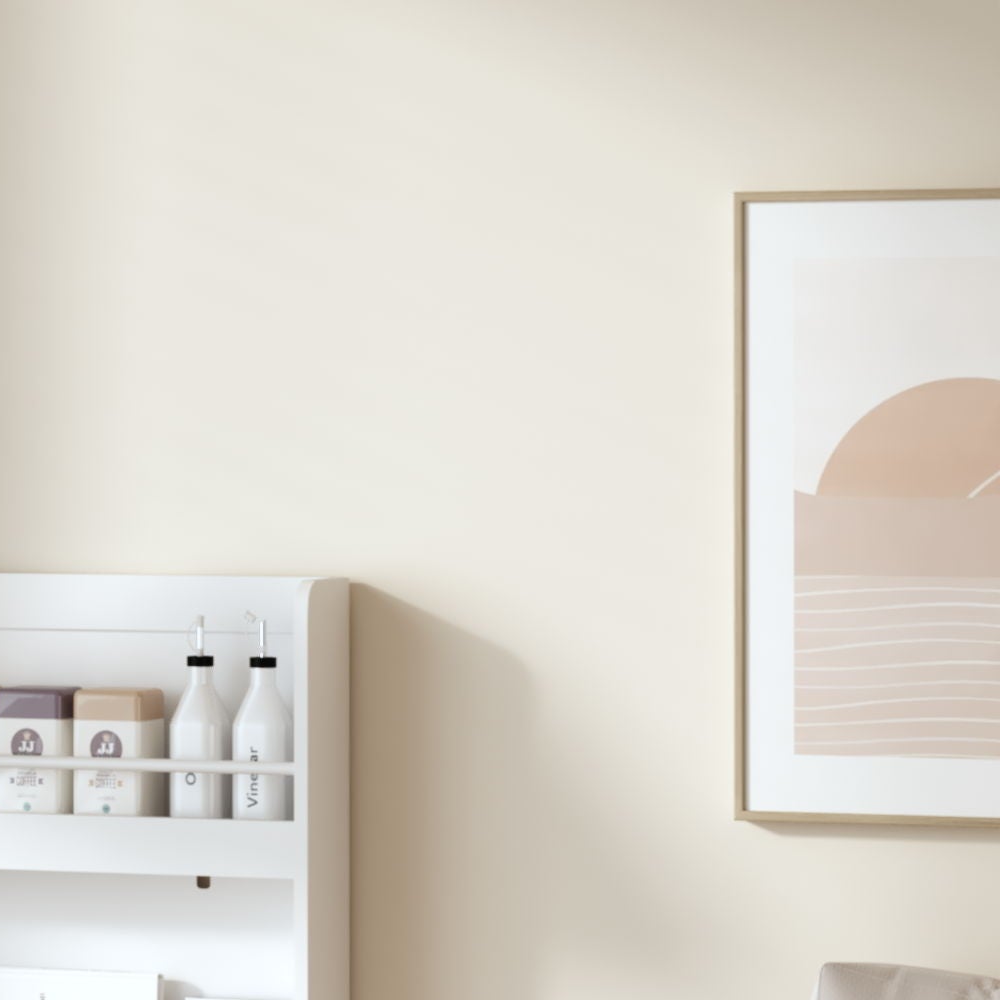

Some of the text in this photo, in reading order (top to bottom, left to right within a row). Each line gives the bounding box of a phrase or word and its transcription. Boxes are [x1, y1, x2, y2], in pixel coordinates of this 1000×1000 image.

[18, 740, 35, 752] JJ
[97, 742, 114, 755] JJ
[246, 746, 259, 808] Vinear
